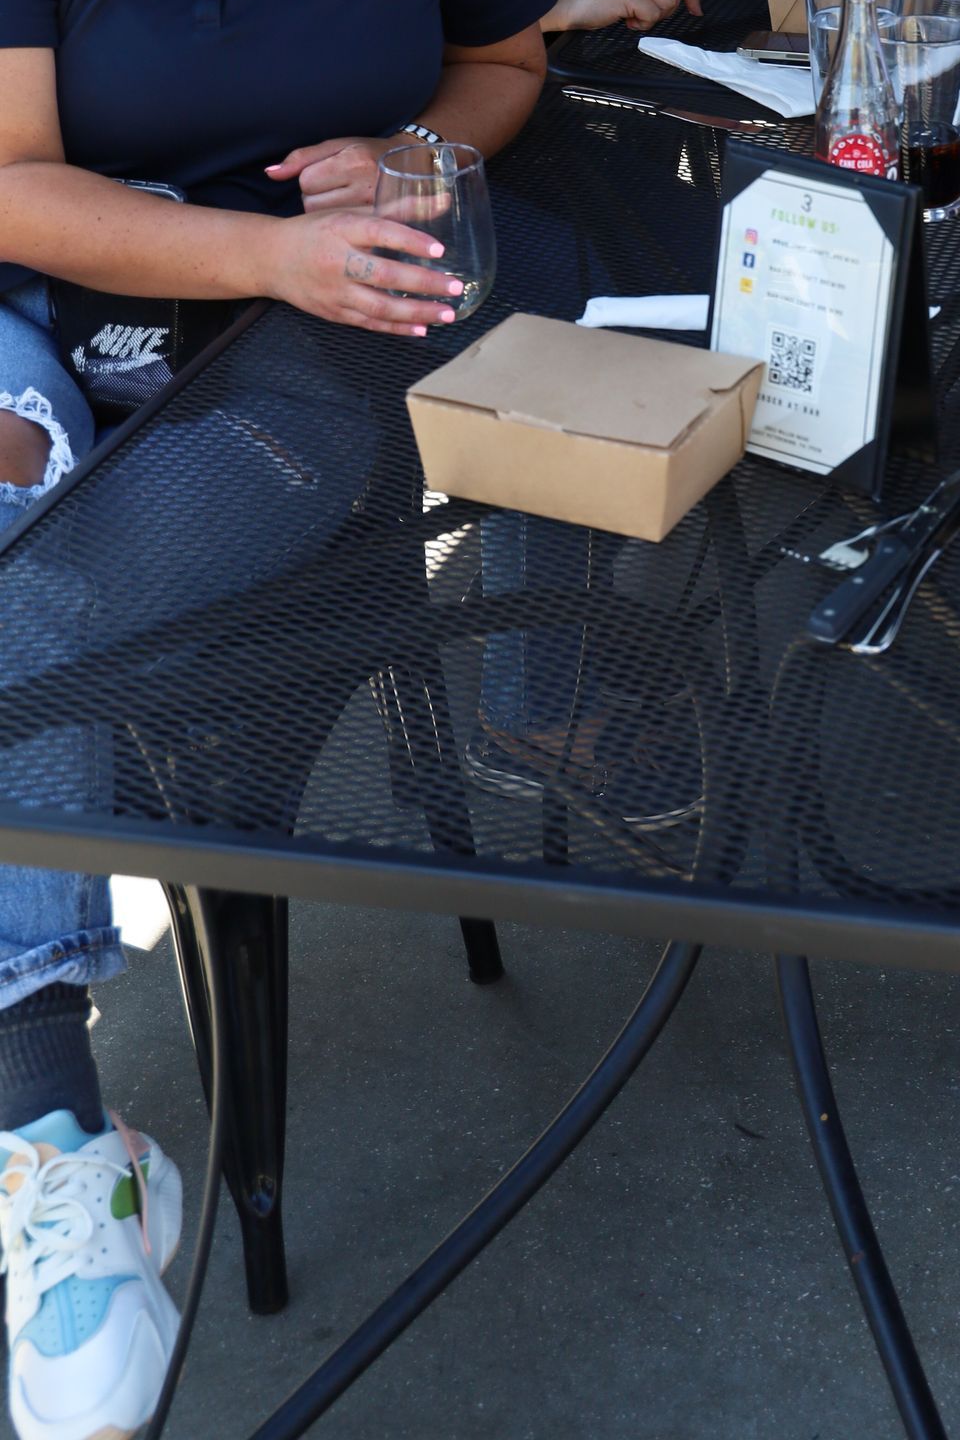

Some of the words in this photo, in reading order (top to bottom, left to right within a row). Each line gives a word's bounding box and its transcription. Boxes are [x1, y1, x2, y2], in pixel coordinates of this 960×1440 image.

[832, 138, 881, 157] BOYLAN
[857, 159, 873, 169] COLA
[801, 193, 813, 213] 3
[771, 208, 817, 229] FOLLOW
[90, 323, 170, 359] NIKE
